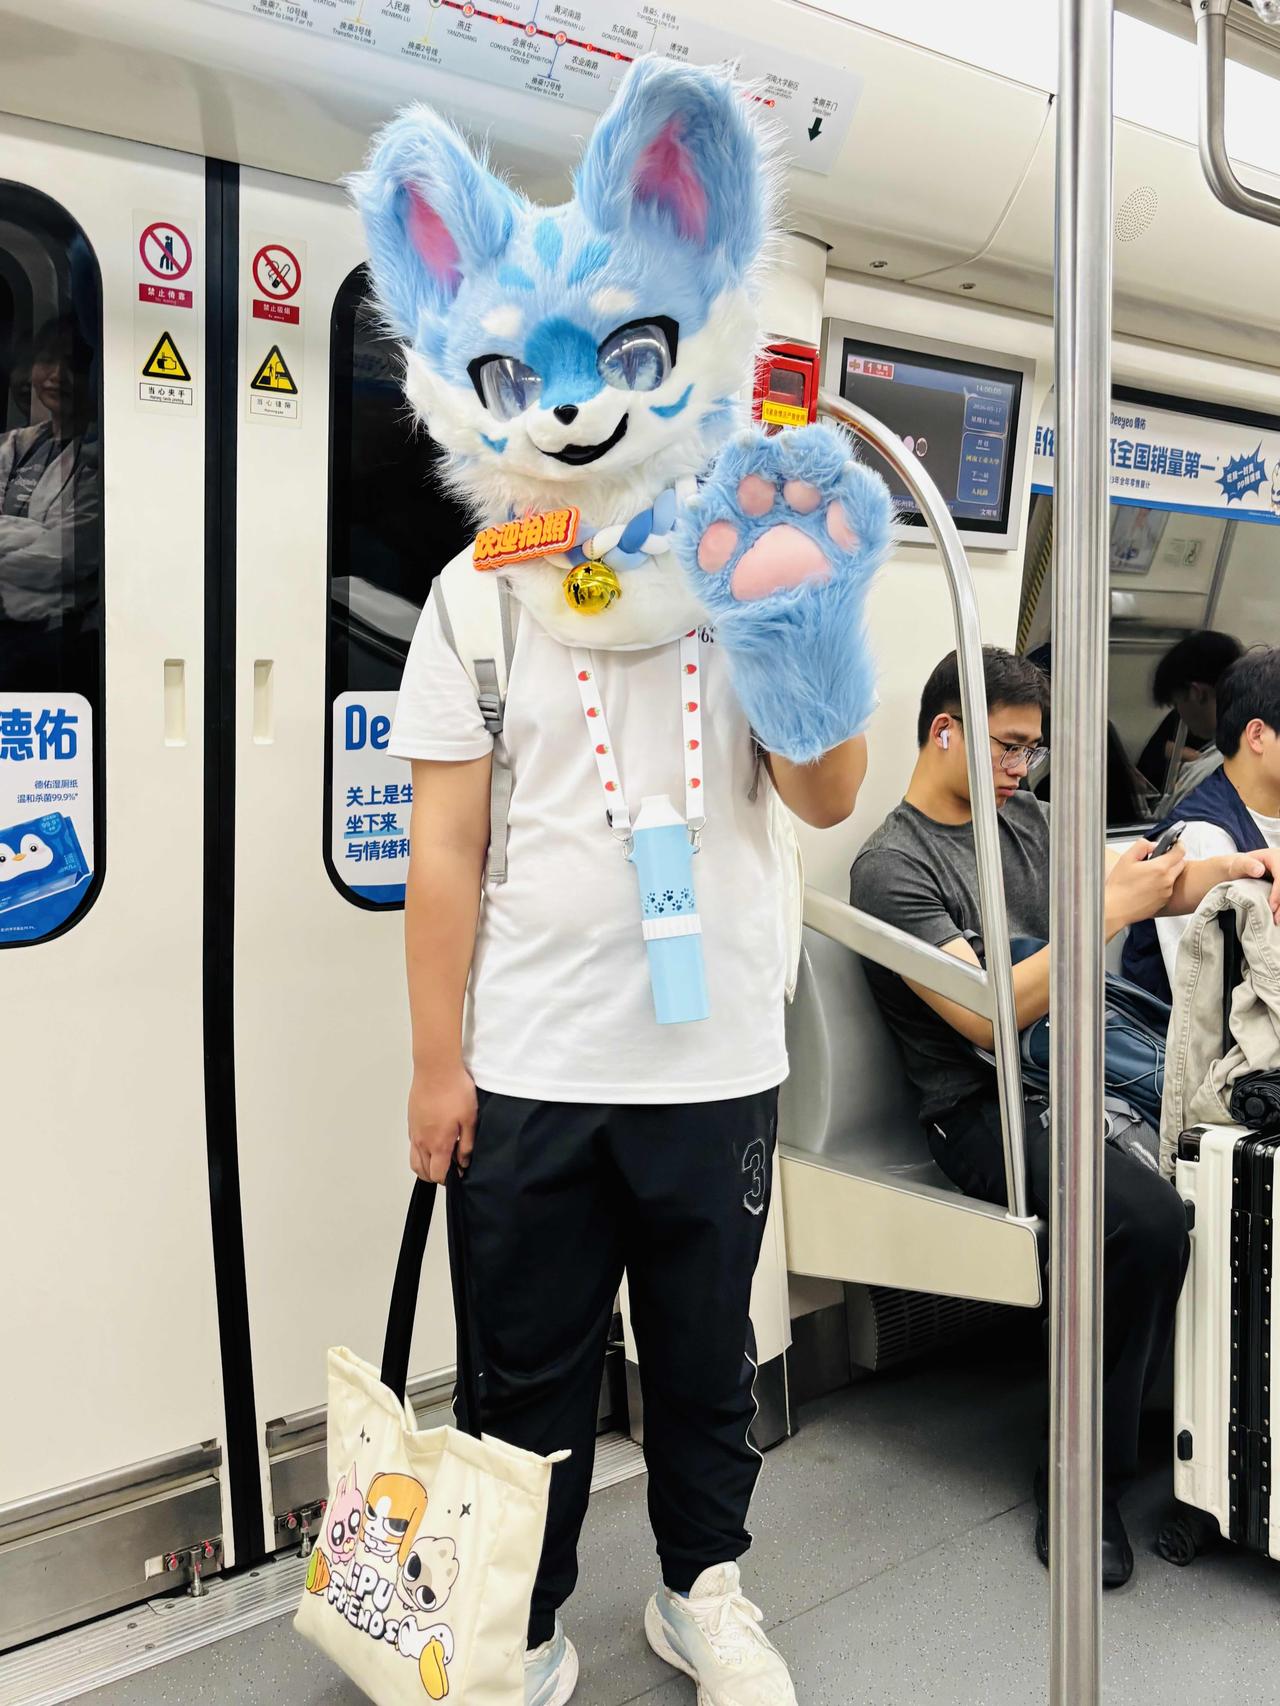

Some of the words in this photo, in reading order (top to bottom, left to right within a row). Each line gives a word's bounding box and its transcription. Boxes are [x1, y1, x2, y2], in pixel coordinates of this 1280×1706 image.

[408, 41, 438, 56] 换乘2号线
[489, 42, 523, 57] CONVENTION
[512, 37, 540, 53] 会展中心
[509, 54, 530, 65] CENTER
[571, 55, 599, 70] 农业南路
[473, 510, 571, 562] 欢迎拍照
[34, 779, 78, 789] 德佑湿厕纸
[346, 784, 413, 807] 关上是生
[346, 812, 398, 835] 坐下来
[742, 1138, 766, 1215] 3
